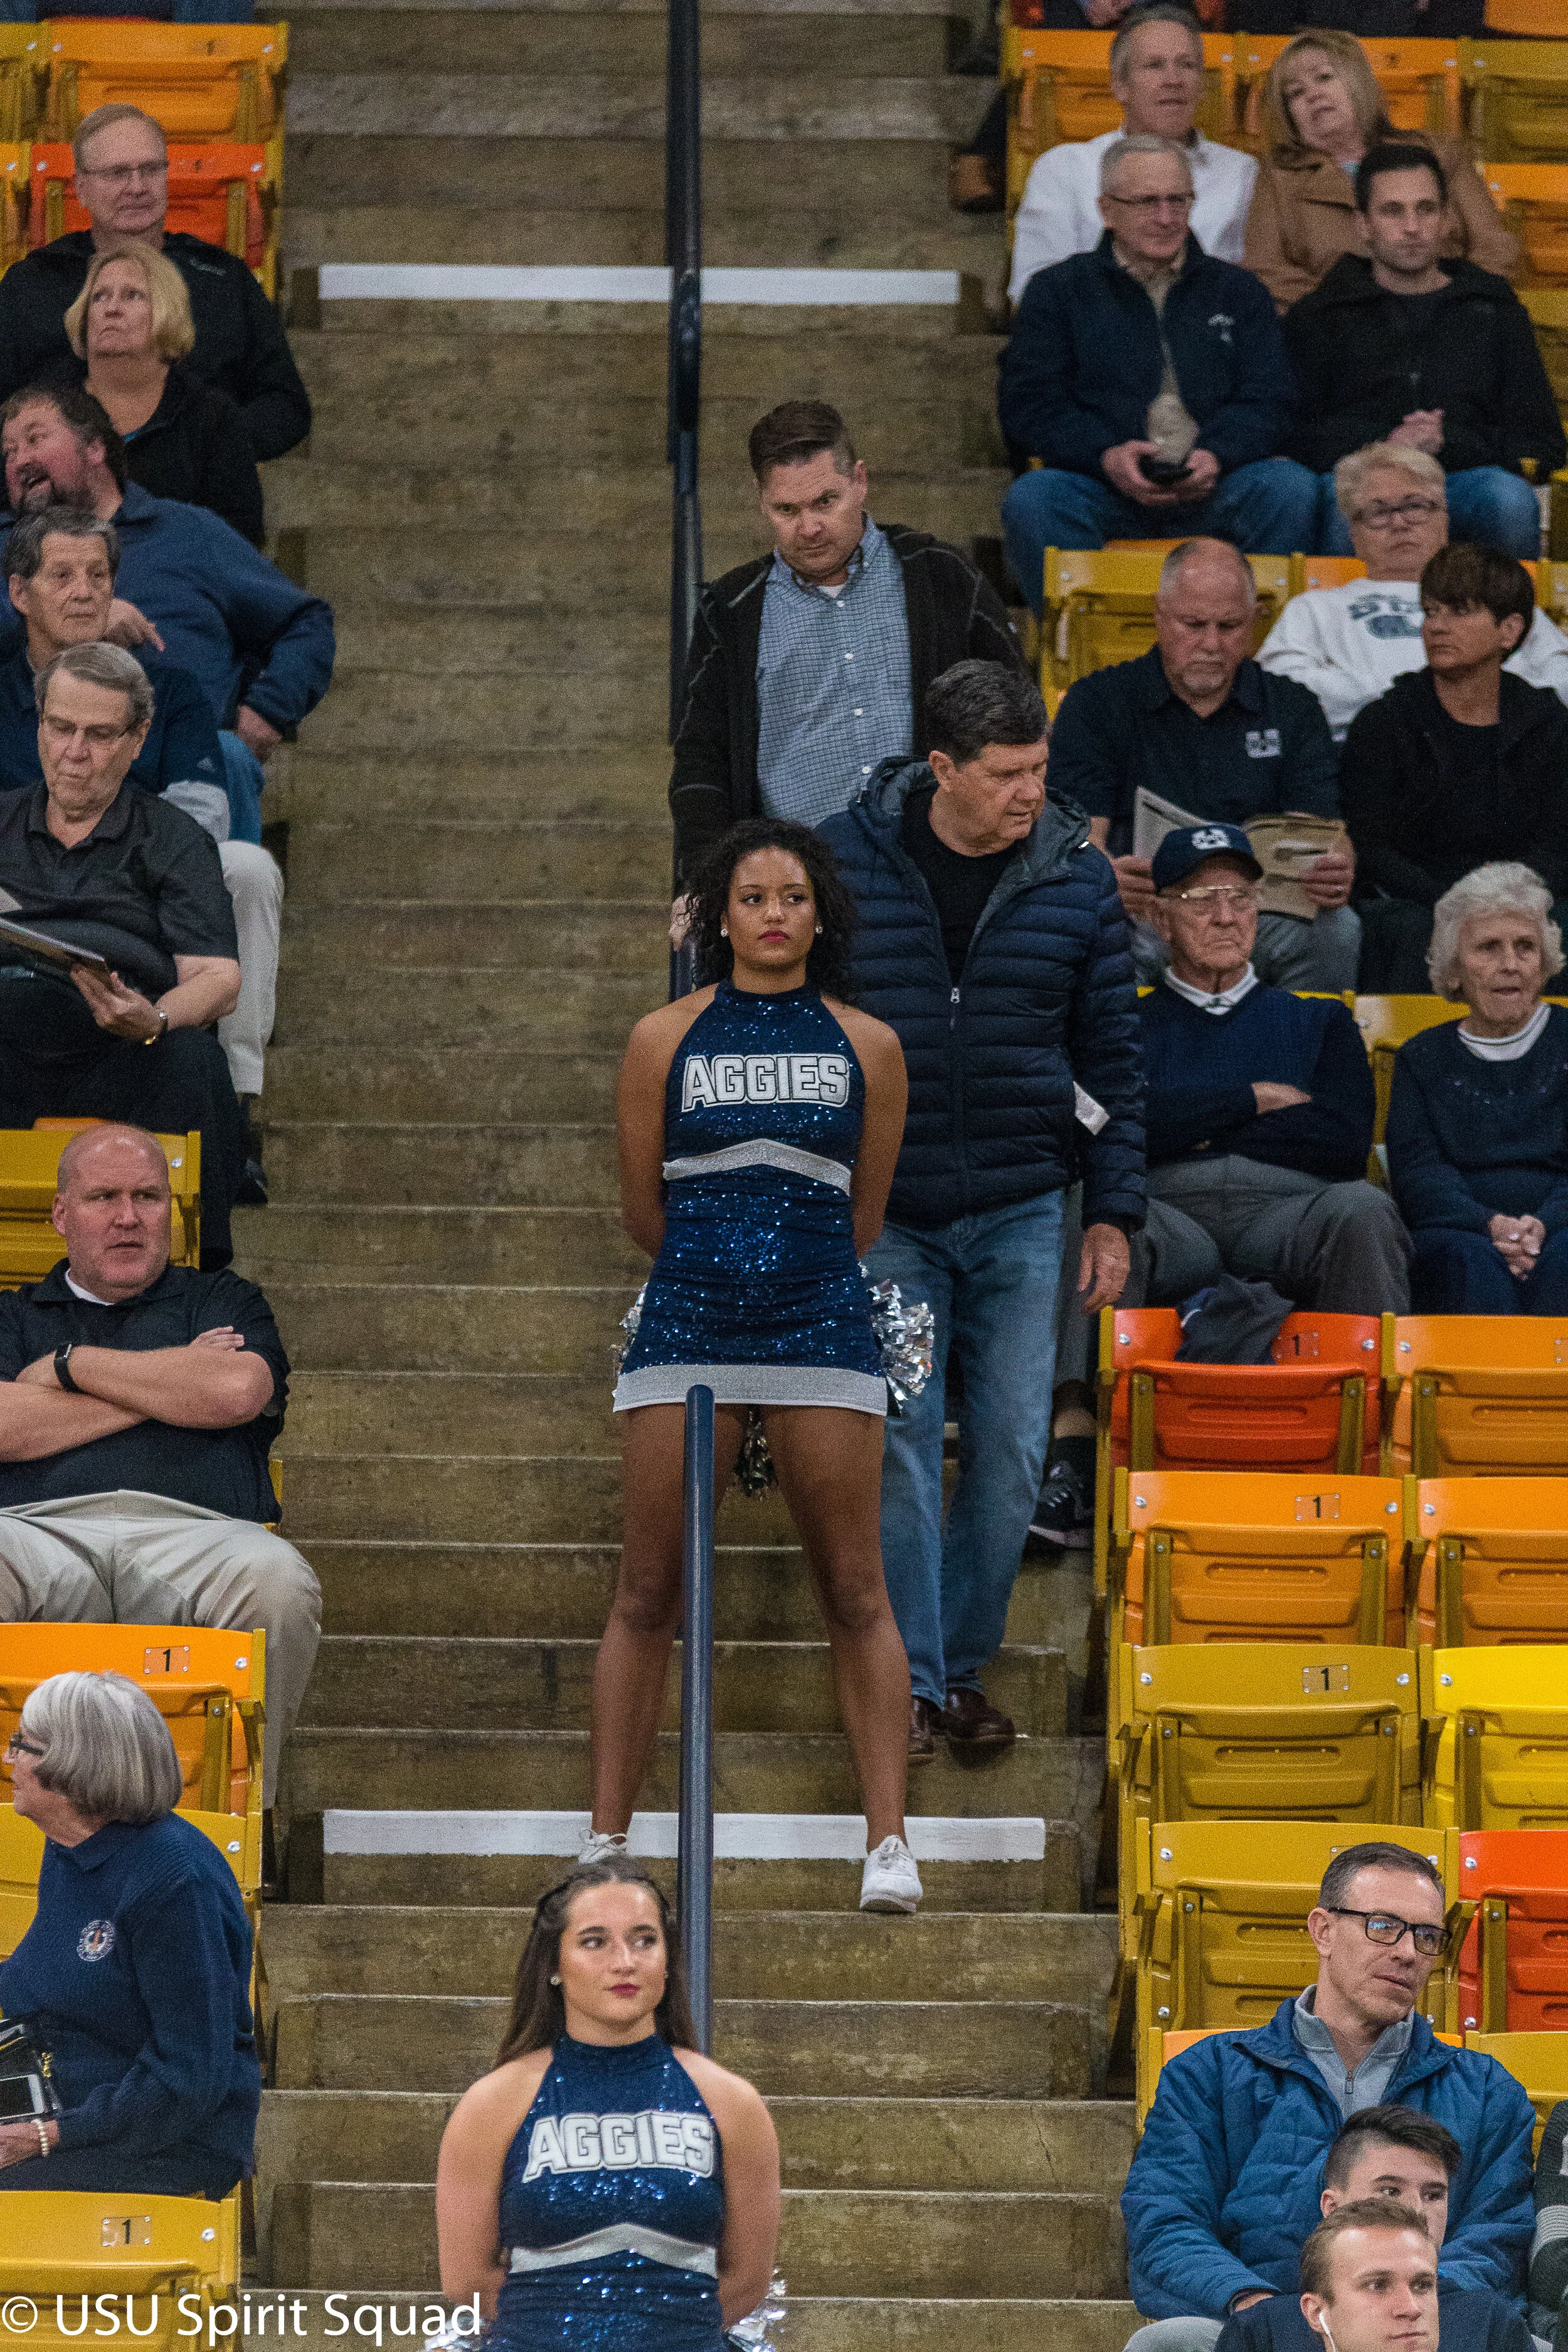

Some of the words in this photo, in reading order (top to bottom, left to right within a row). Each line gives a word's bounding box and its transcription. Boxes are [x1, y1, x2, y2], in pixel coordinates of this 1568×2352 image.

[681, 1054, 850, 1113] AGGIES
[1293, 1334, 1300, 1356] 1
[1312, 1496, 1321, 1518] 1
[162, 1648, 171, 1671] 1
[1320, 1667, 1329, 1690] 1
[522, 2110, 714, 2183] AGGIES
[121, 2218, 130, 2244] 1
